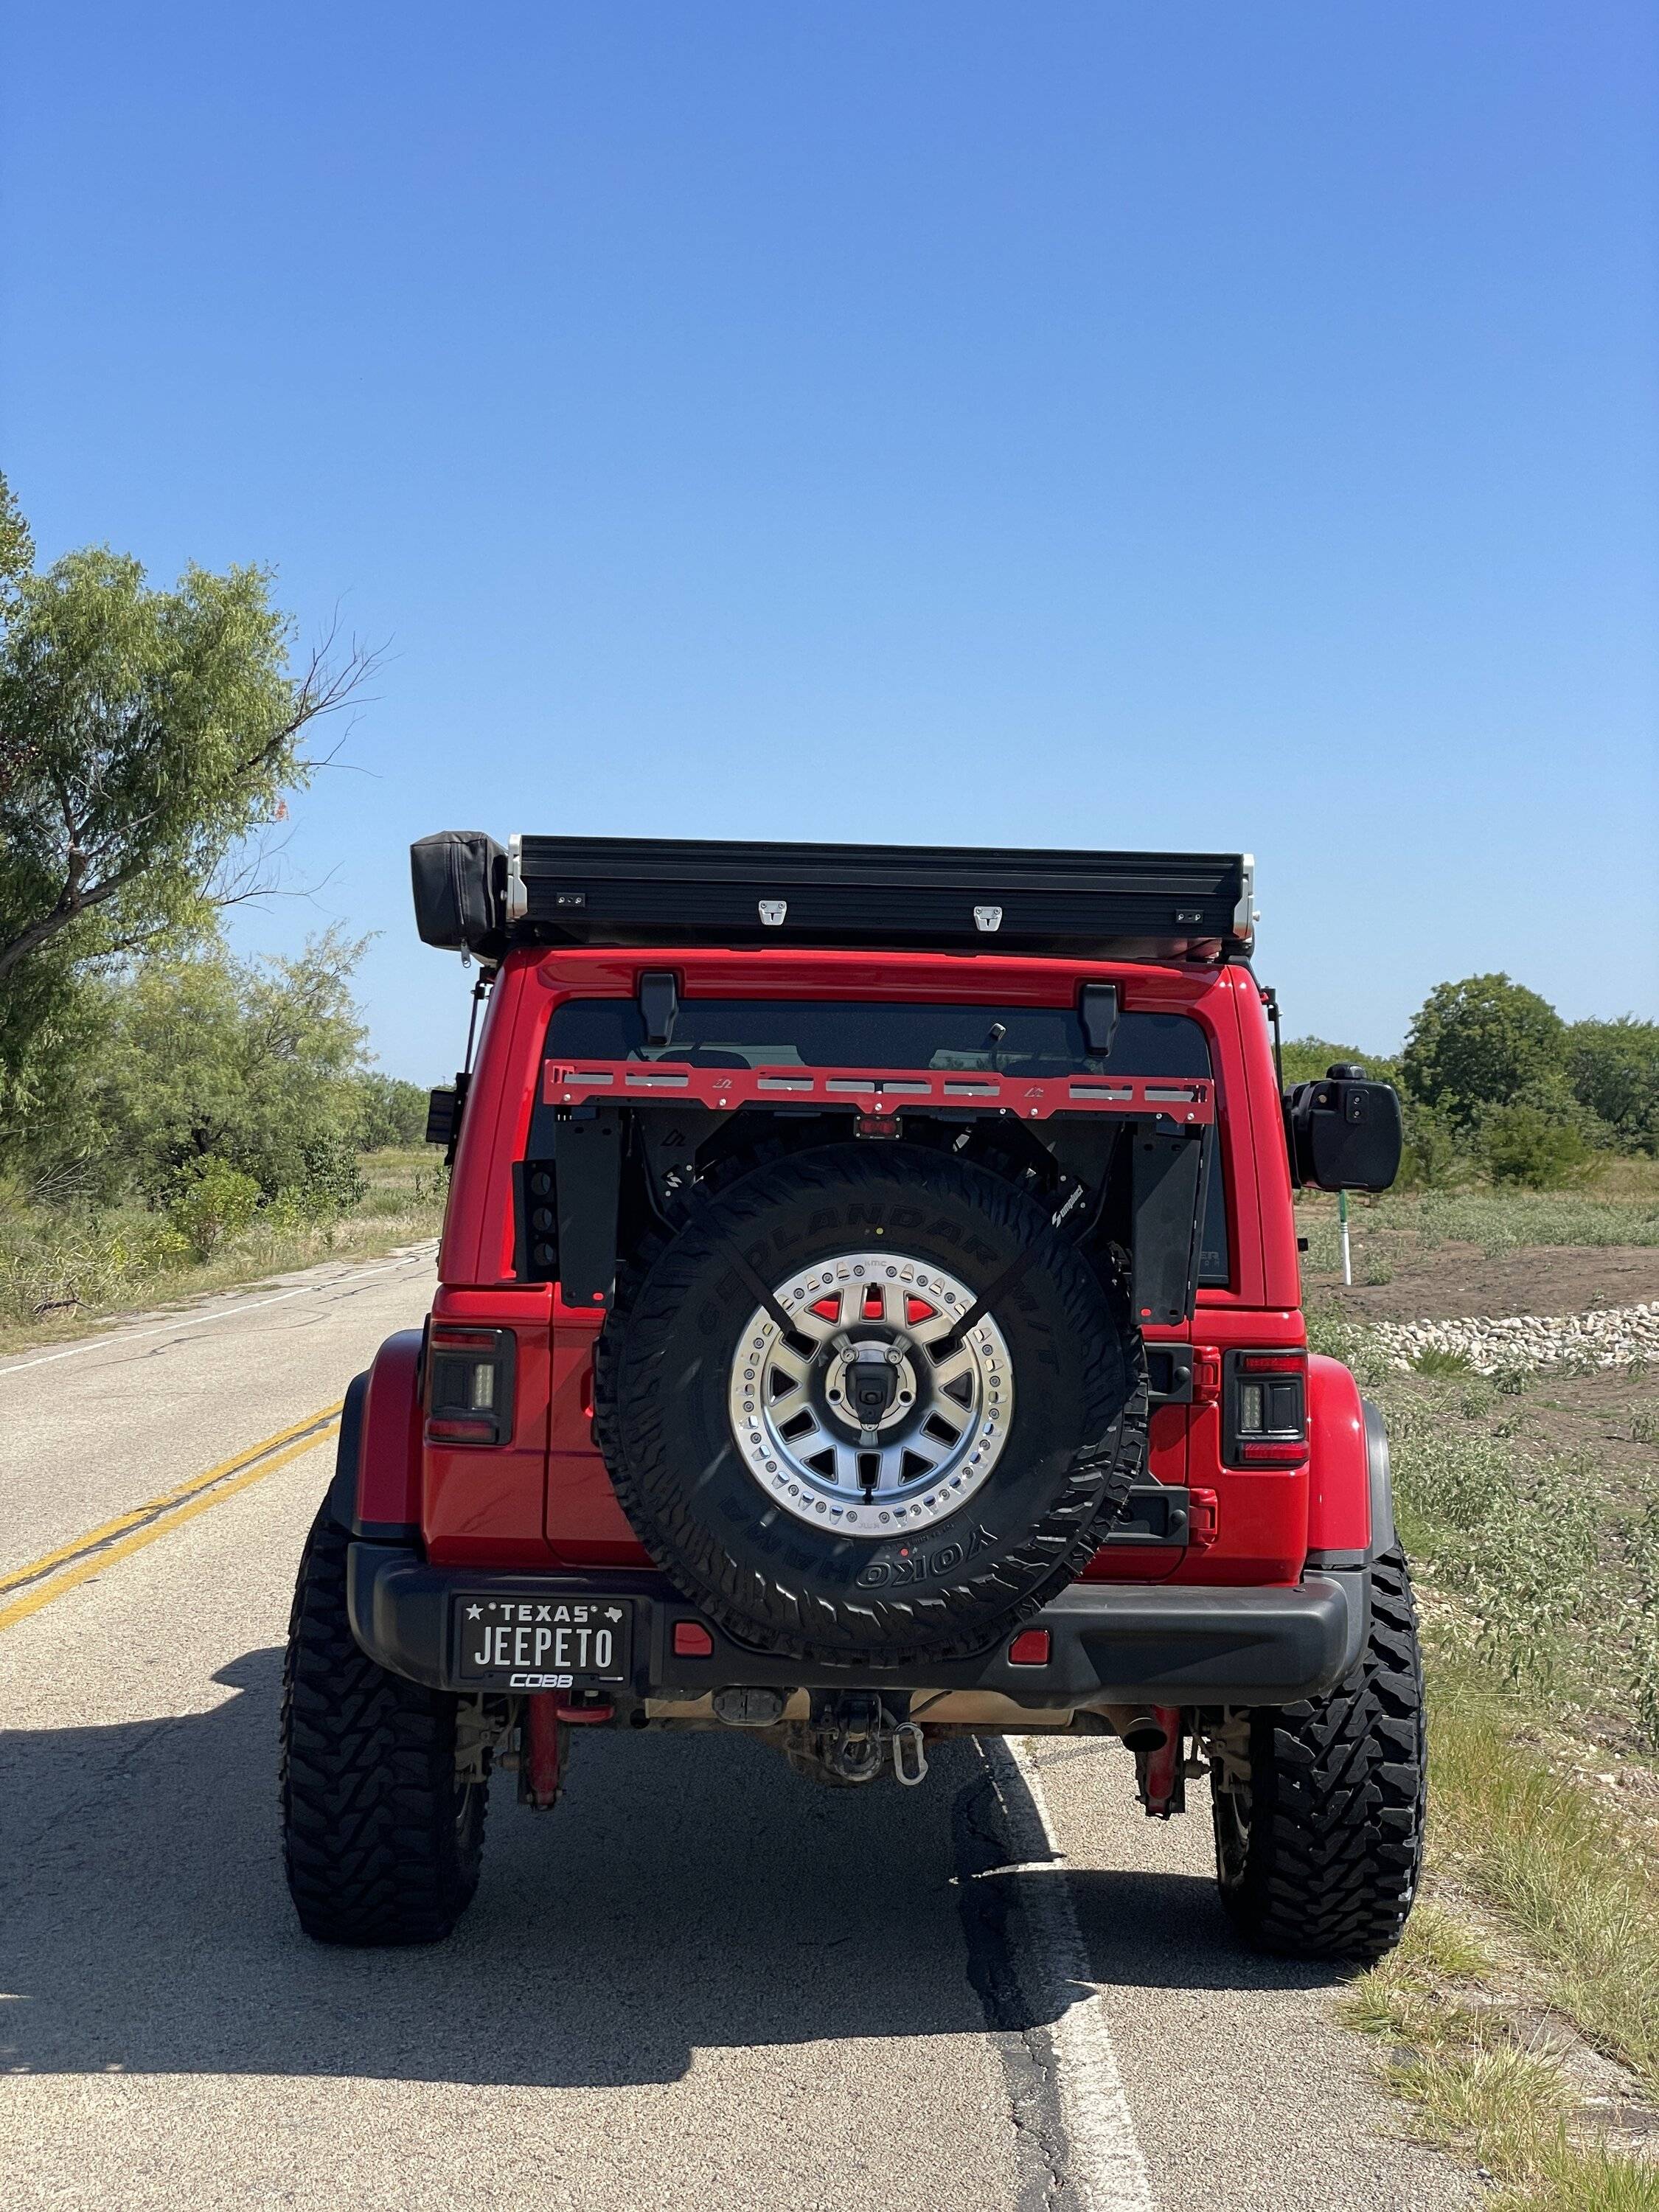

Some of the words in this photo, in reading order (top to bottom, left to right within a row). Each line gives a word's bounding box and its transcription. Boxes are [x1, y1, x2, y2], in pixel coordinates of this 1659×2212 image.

[697, 1202, 998, 1333] GEOLANDAR
[718, 1493, 1001, 1590] YOKOHAMA
[500, 1604, 588, 1622] TEXAS
[475, 1626, 612, 1668] JEEPETO
[509, 1674, 573, 1688] COBB
